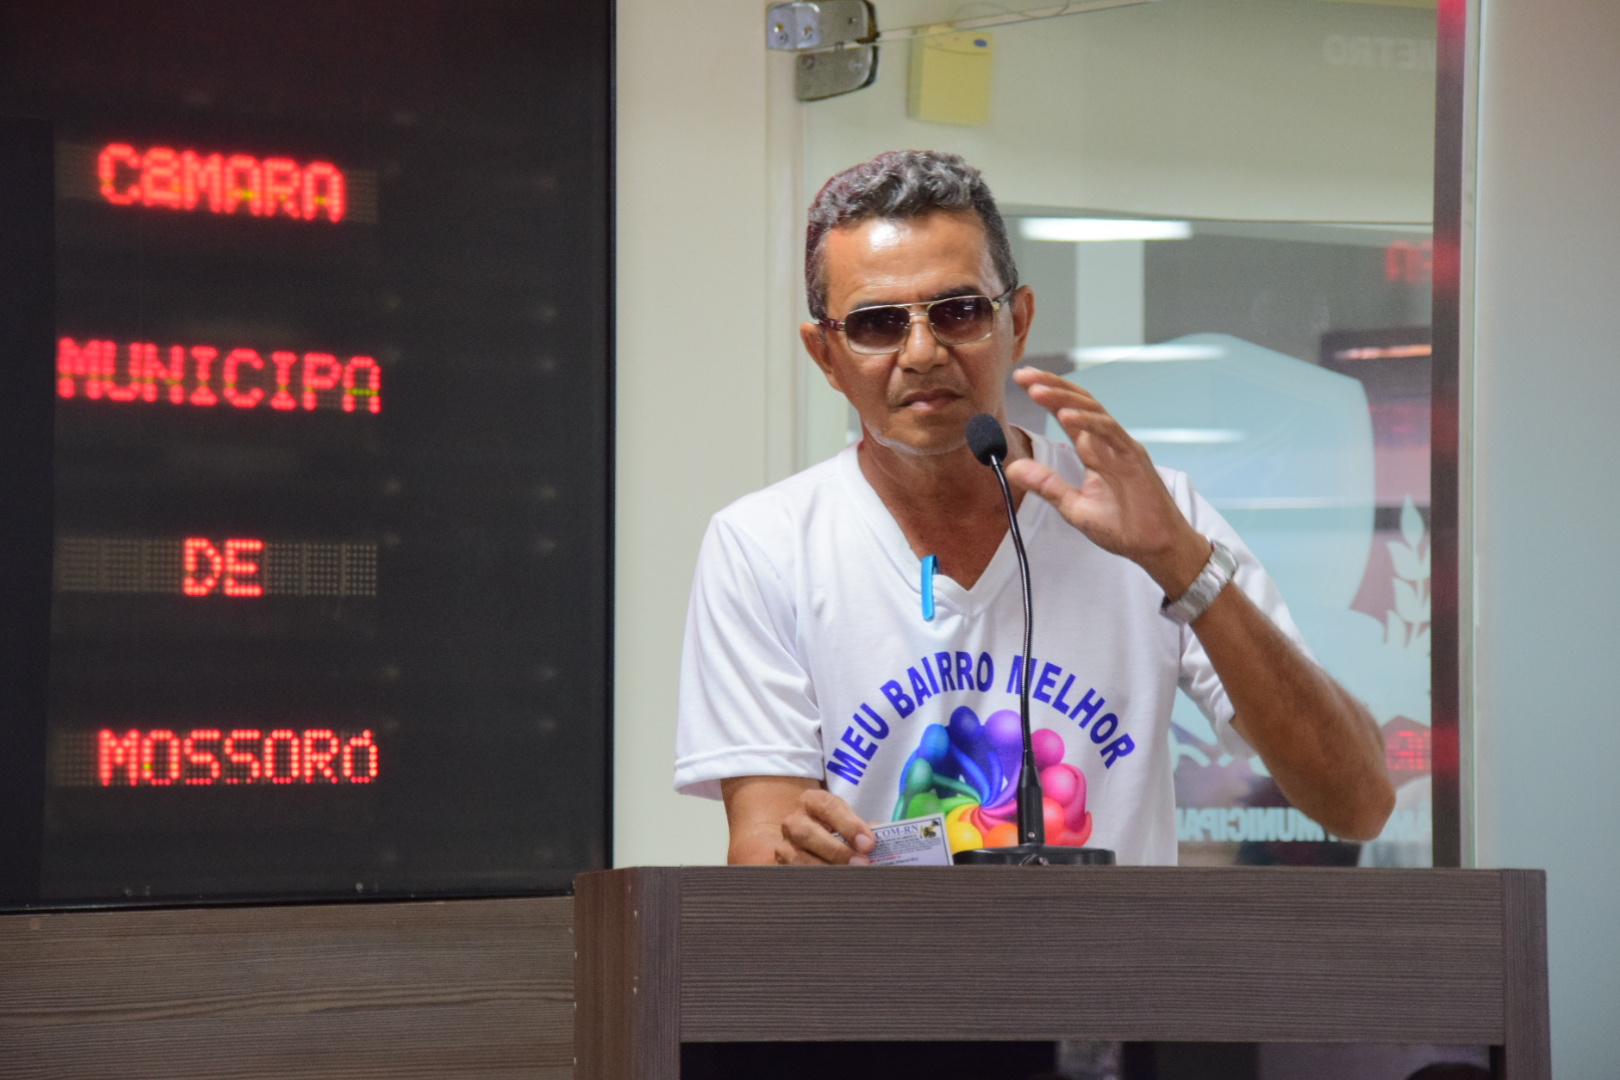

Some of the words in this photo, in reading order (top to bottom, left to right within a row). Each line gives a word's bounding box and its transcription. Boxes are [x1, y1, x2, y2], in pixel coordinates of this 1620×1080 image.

[57, 337, 381, 413] MUNICIPA
[184, 537, 264, 597] DE
[826, 703, 890, 786] MEU
[880, 651, 995, 719] BAIRRO
[1006, 655, 1136, 769] MELHOR
